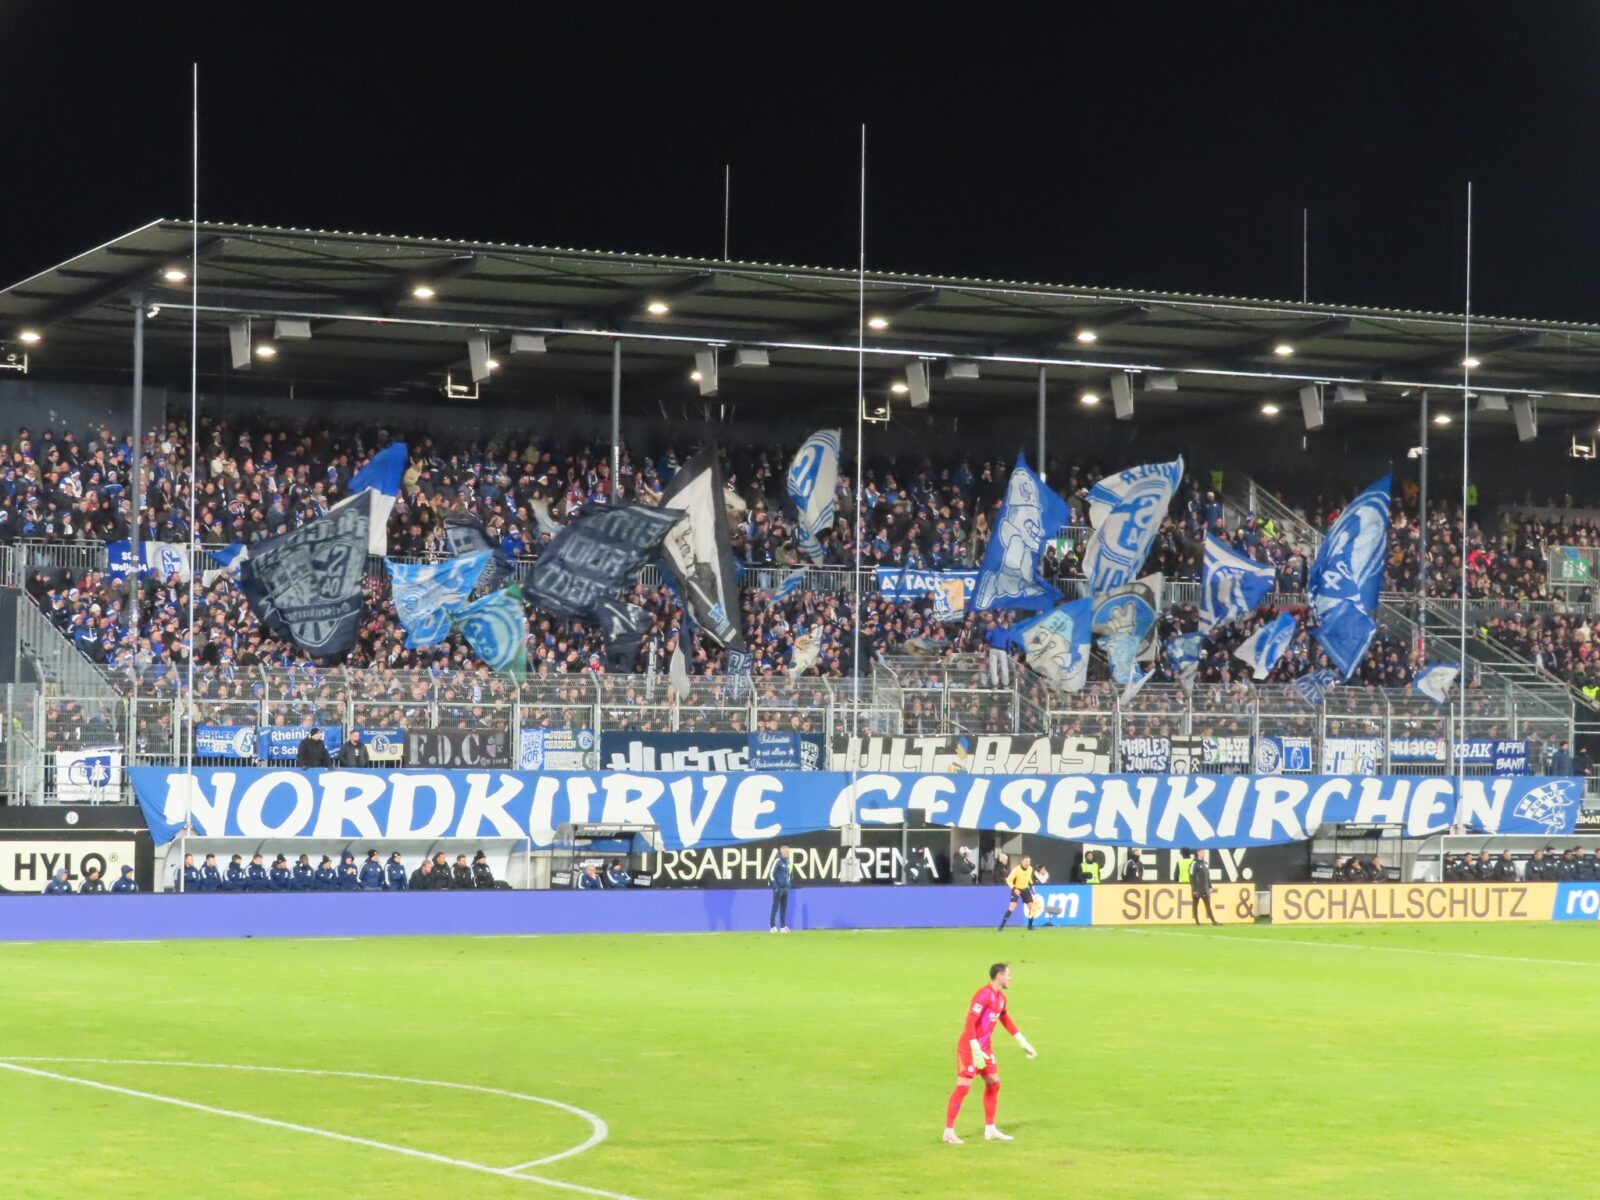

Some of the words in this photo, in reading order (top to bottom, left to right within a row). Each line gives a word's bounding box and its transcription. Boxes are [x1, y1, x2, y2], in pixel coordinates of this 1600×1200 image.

[271, 729, 325, 742] Rheinld
[1122, 739, 1169, 756] MARLER
[846, 737, 1099, 773] ULTRAS
[1127, 756, 1167, 772] JUNGS
[164, 772, 785, 849] NORDKURVE
[1236, 888, 1255, 919] &
[1284, 888, 1527, 921] SCHALLSCHUTZ
